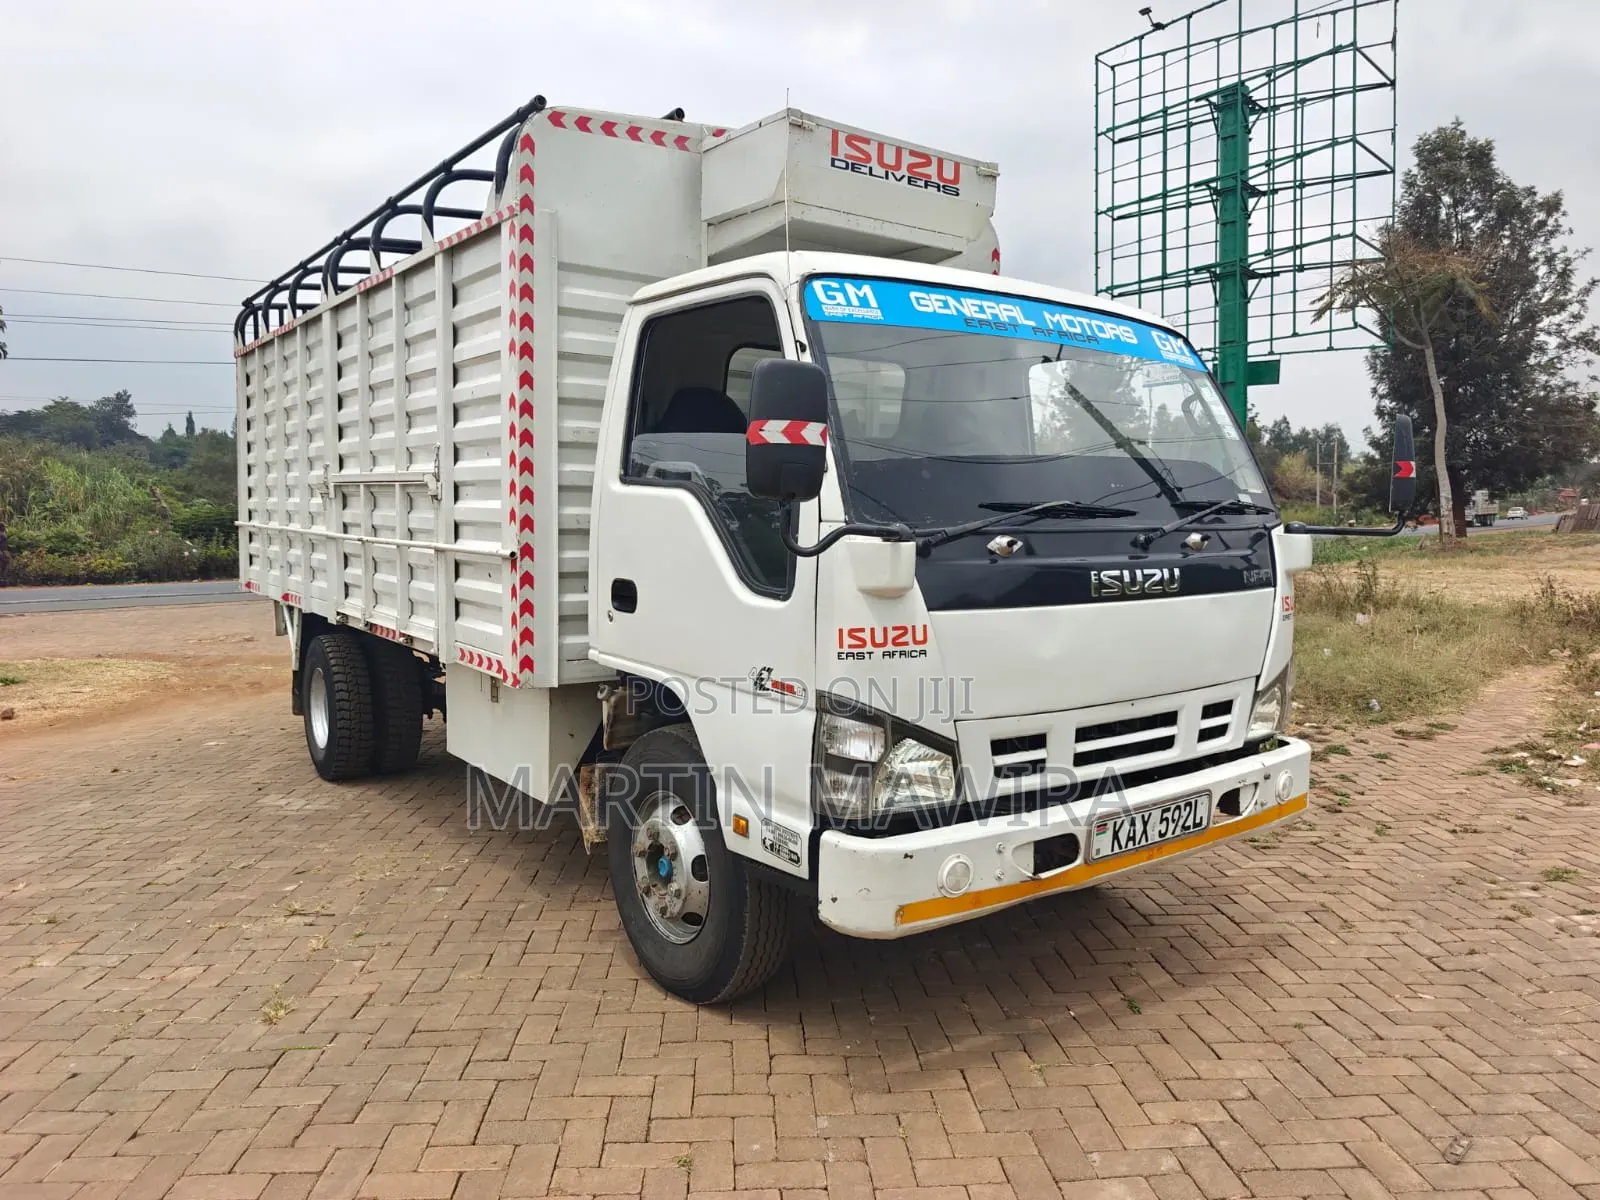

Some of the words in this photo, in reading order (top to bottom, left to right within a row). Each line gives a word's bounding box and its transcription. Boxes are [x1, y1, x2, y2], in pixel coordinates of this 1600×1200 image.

[830, 128, 961, 186] ISUZU
[830, 157, 960, 197] DELIVERS
[812, 280, 879, 309] GM
[909, 291, 1036, 327] GENERAL
[1043, 311, 1138, 345] MOTORS
[964, 317, 1019, 334] EAST
[1032, 327, 1100, 345] AFRICA
[1150, 330, 1191, 357] GM
[1090, 567, 1180, 597] ISUZU
[838, 624, 928, 649] ISUZU
[837, 651, 874, 661] EAST
[882, 649, 927, 660] AFRICA
[1111, 812, 1152, 852] KAX
[1158, 799, 1203, 839] 592L
